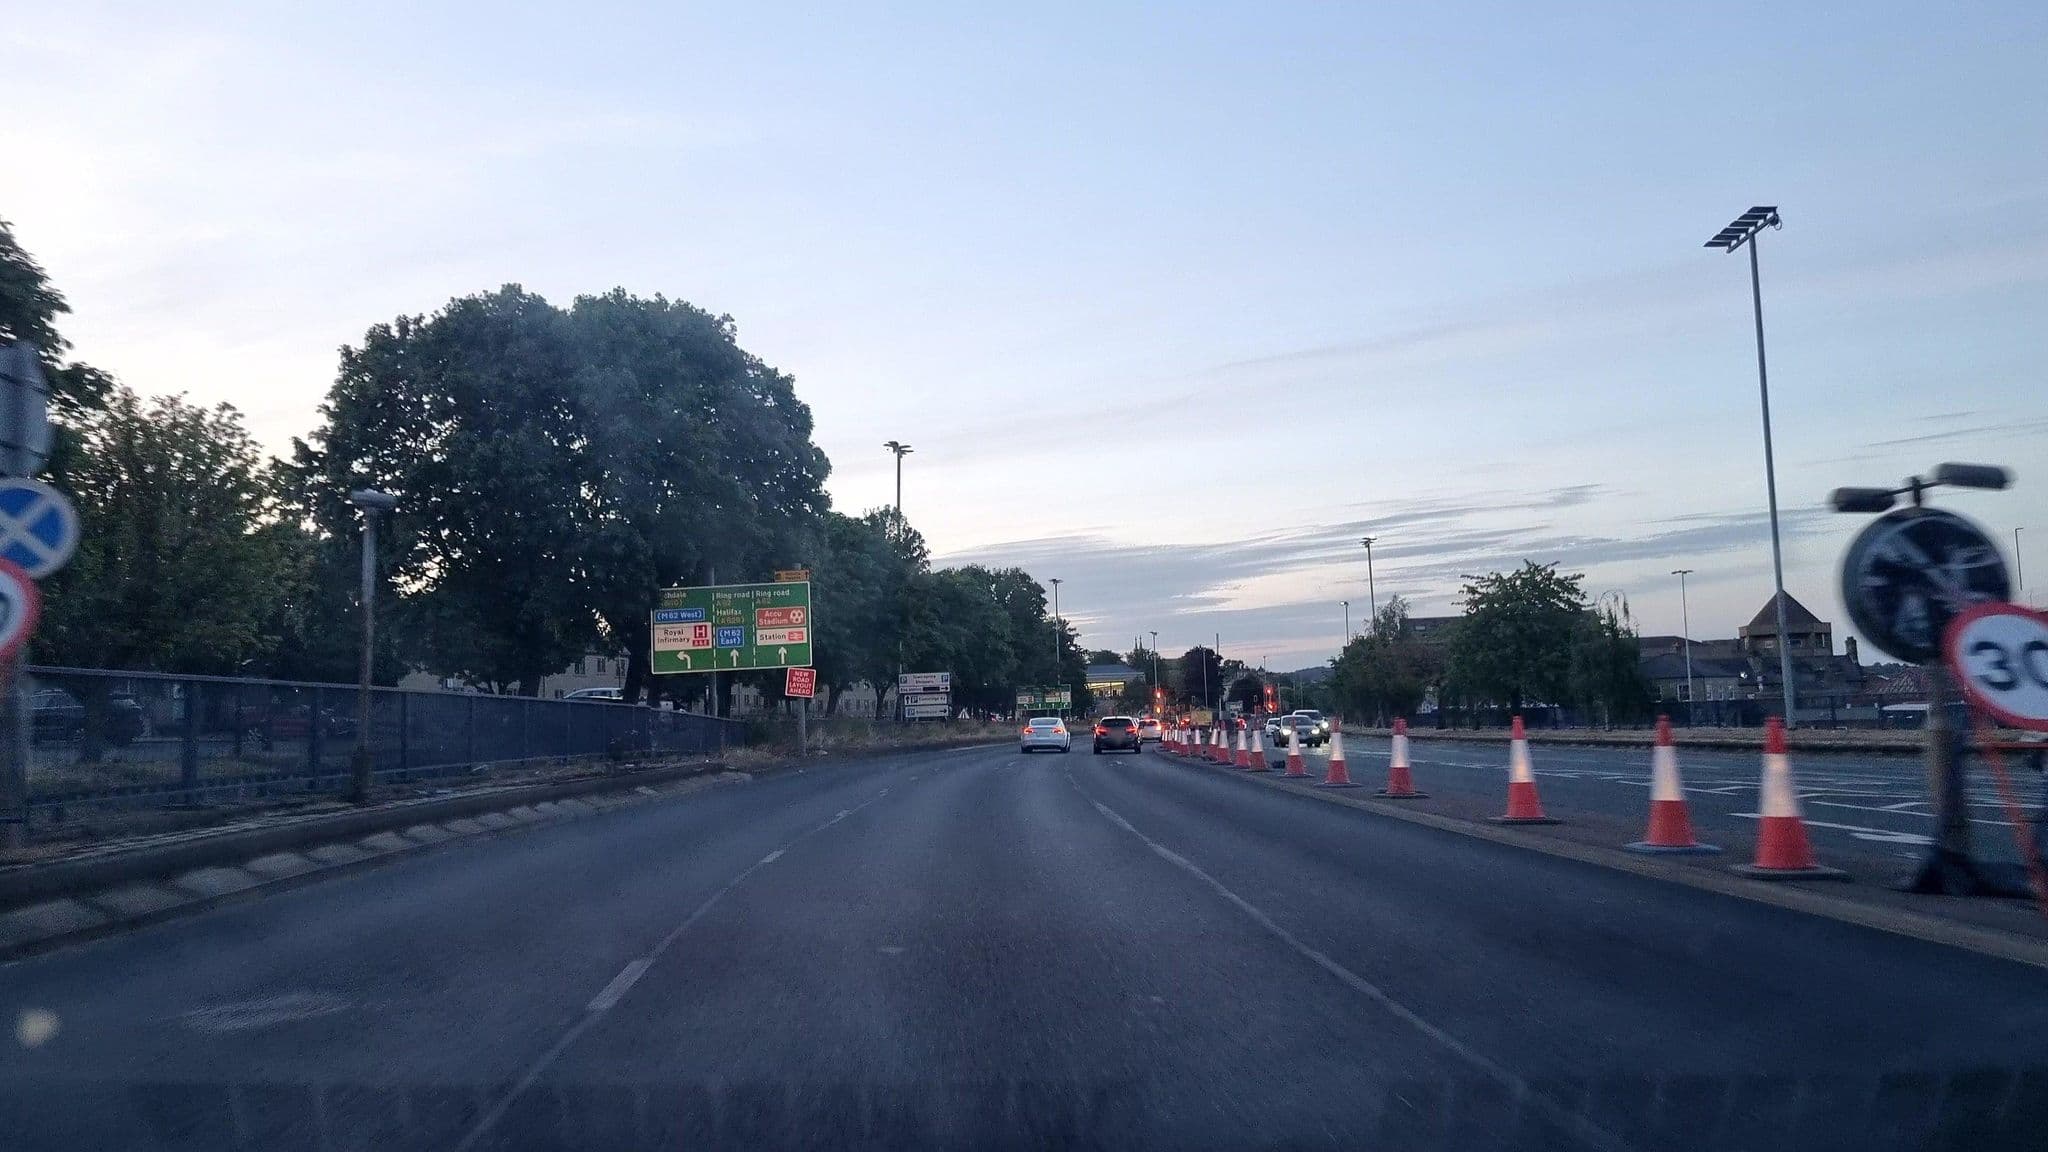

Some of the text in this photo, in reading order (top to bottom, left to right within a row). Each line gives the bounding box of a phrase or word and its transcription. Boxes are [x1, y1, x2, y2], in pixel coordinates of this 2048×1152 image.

[755, 590, 772, 598] Ring
[680, 609, 702, 619] West)
[716, 608, 742, 616] Halifax
[758, 617, 789, 626] Stadium
[663, 629, 684, 637] Royal
[759, 633, 787, 641] Station
[657, 636, 690, 645] Infirmary
[720, 637, 741, 645] East)
